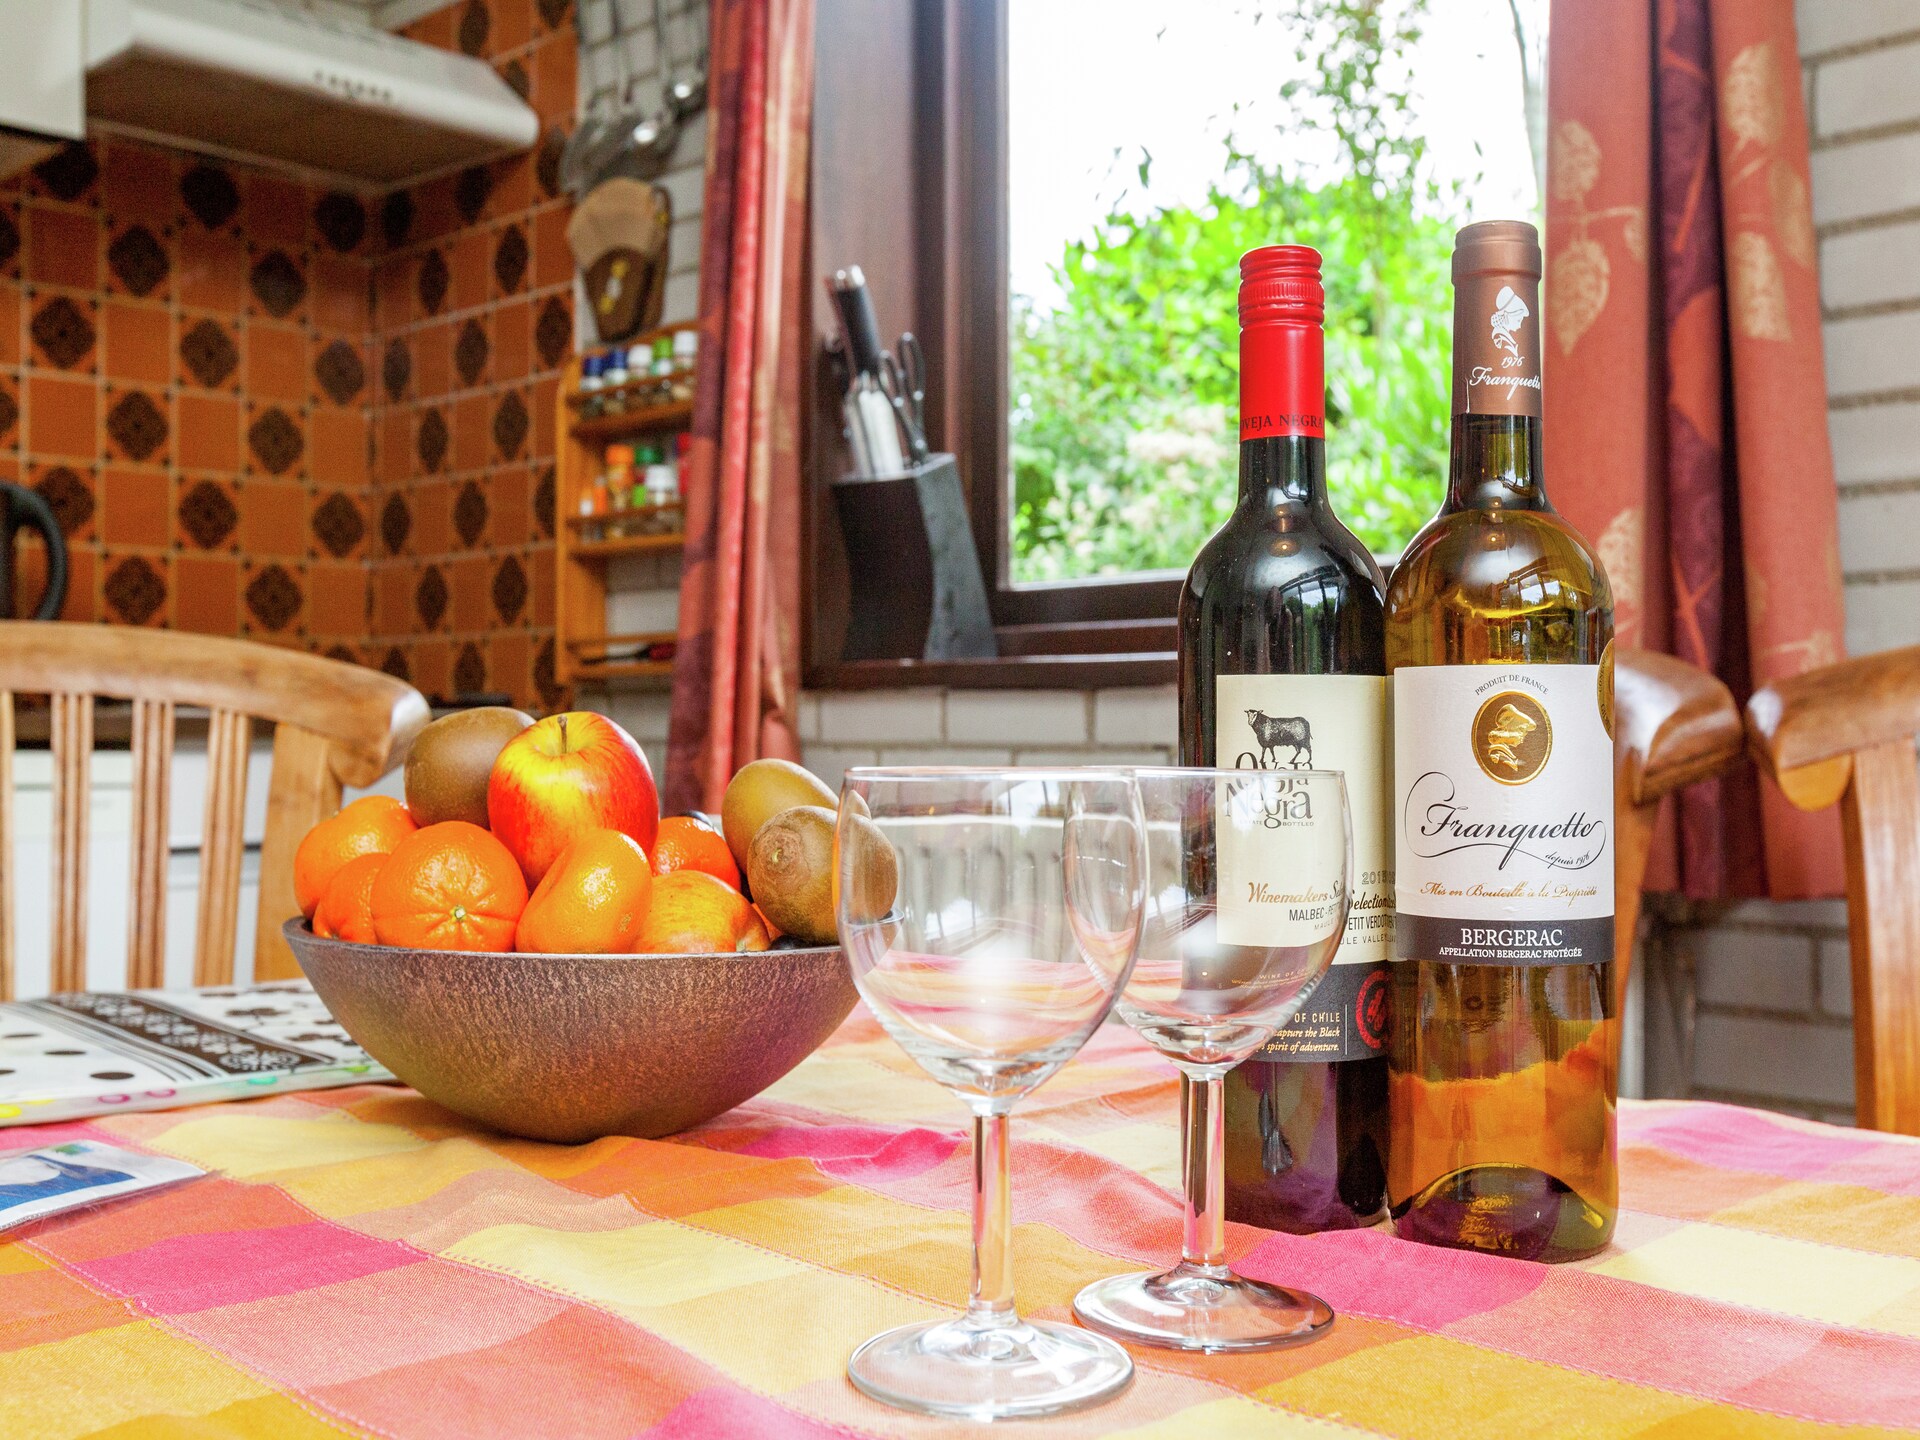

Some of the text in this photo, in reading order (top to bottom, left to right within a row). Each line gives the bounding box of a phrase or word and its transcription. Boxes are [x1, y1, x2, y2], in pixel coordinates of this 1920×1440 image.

[1501, 356, 1525, 368] 1976
[1469, 366, 1540, 400] Franquett
[1279, 414, 1323, 428] NEGRA
[1475, 674, 1507, 695] PRODUIT
[1521, 675, 1549, 694] FRANCE
[1420, 803, 1600, 870] Franquette
[1545, 849, 1574, 869] depuis
[1248, 882, 1328, 903] Winemakers
[1420, 881, 1446, 896] Mis
[1449, 889, 1462, 897] en
[1289, 907, 1324, 921] MALBEC
[1348, 916, 1364, 931] ETIT
[1461, 928, 1563, 946] BERGERAC
[1439, 946, 1583, 958] APPELLATION BERGERAC PROTÉGÉE
[1294, 1011, 1340, 1023] OF CHILE
[1304, 1026, 1318, 1038] the
[1319, 1026, 1340, 1038] Black
[1266, 1041, 1288, 1054] spirit
[1289, 1040, 1300, 1054] of
[1299, 1041, 1340, 1052] adventure.
